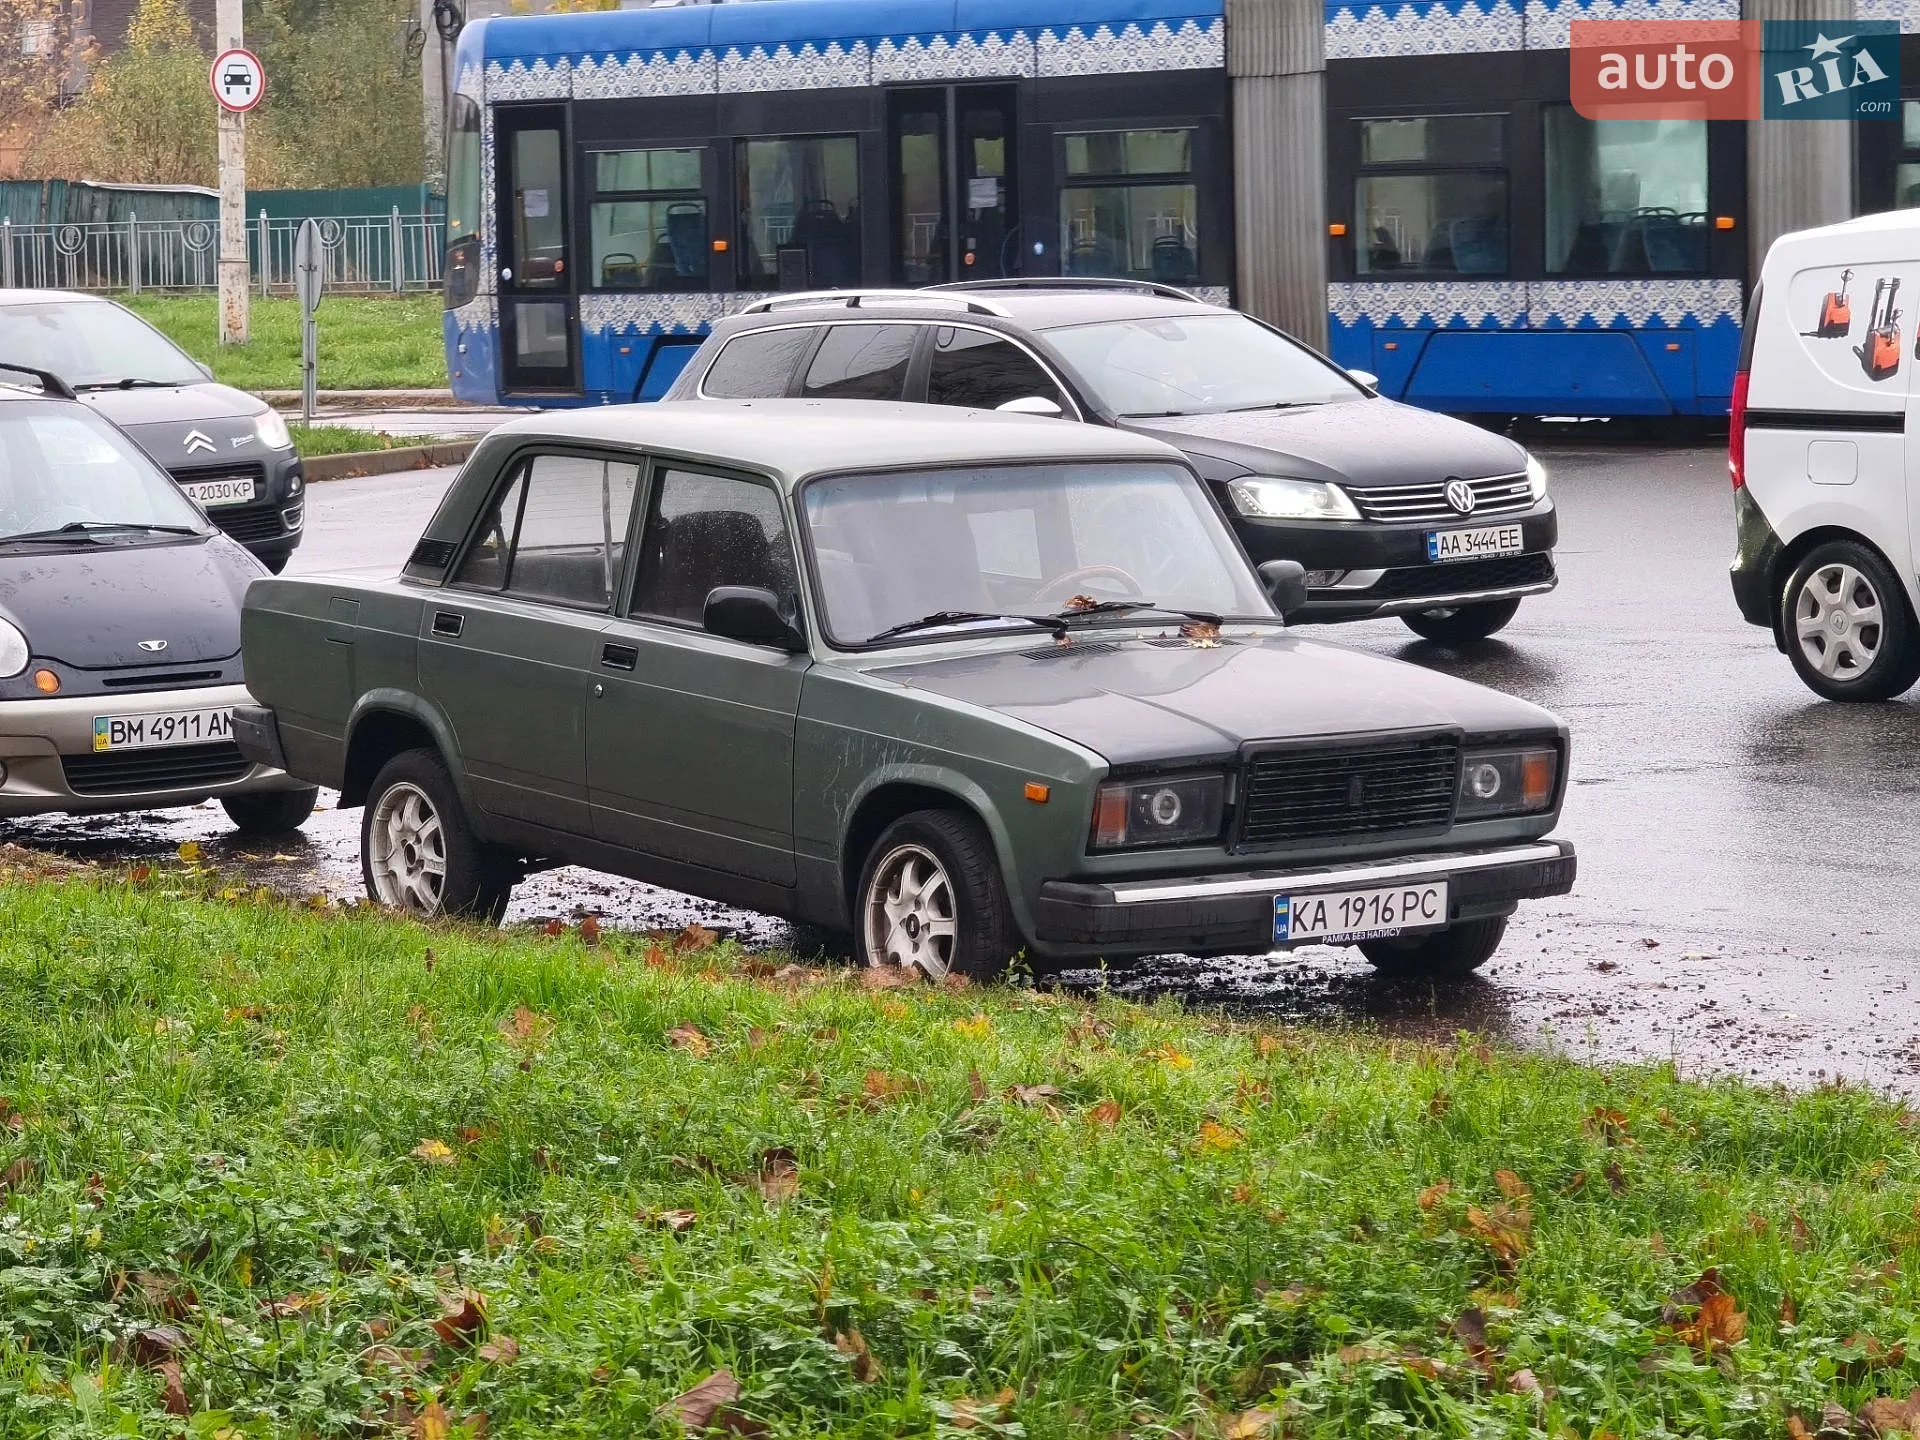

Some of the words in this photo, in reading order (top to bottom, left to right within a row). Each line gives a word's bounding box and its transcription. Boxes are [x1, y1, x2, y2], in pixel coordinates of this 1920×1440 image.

[199, 484, 231, 501] 2030
[233, 482, 252, 497] KP
[1440, 534, 1461, 555] AA
[1464, 531, 1497, 552] 3444
[1499, 529, 1520, 549] EE
[110, 719, 144, 744] BM
[150, 714, 201, 741] 4911
[1291, 899, 1328, 933] KA
[1339, 893, 1396, 927] 1916
[1401, 888, 1438, 922] PC
[1276, 924, 1288, 934] UA
[1322, 930, 1351, 944] РАМКА
[1351, 930, 1367, 941] БЕЗ
[1367, 927, 1402, 941] НАПИСУ
